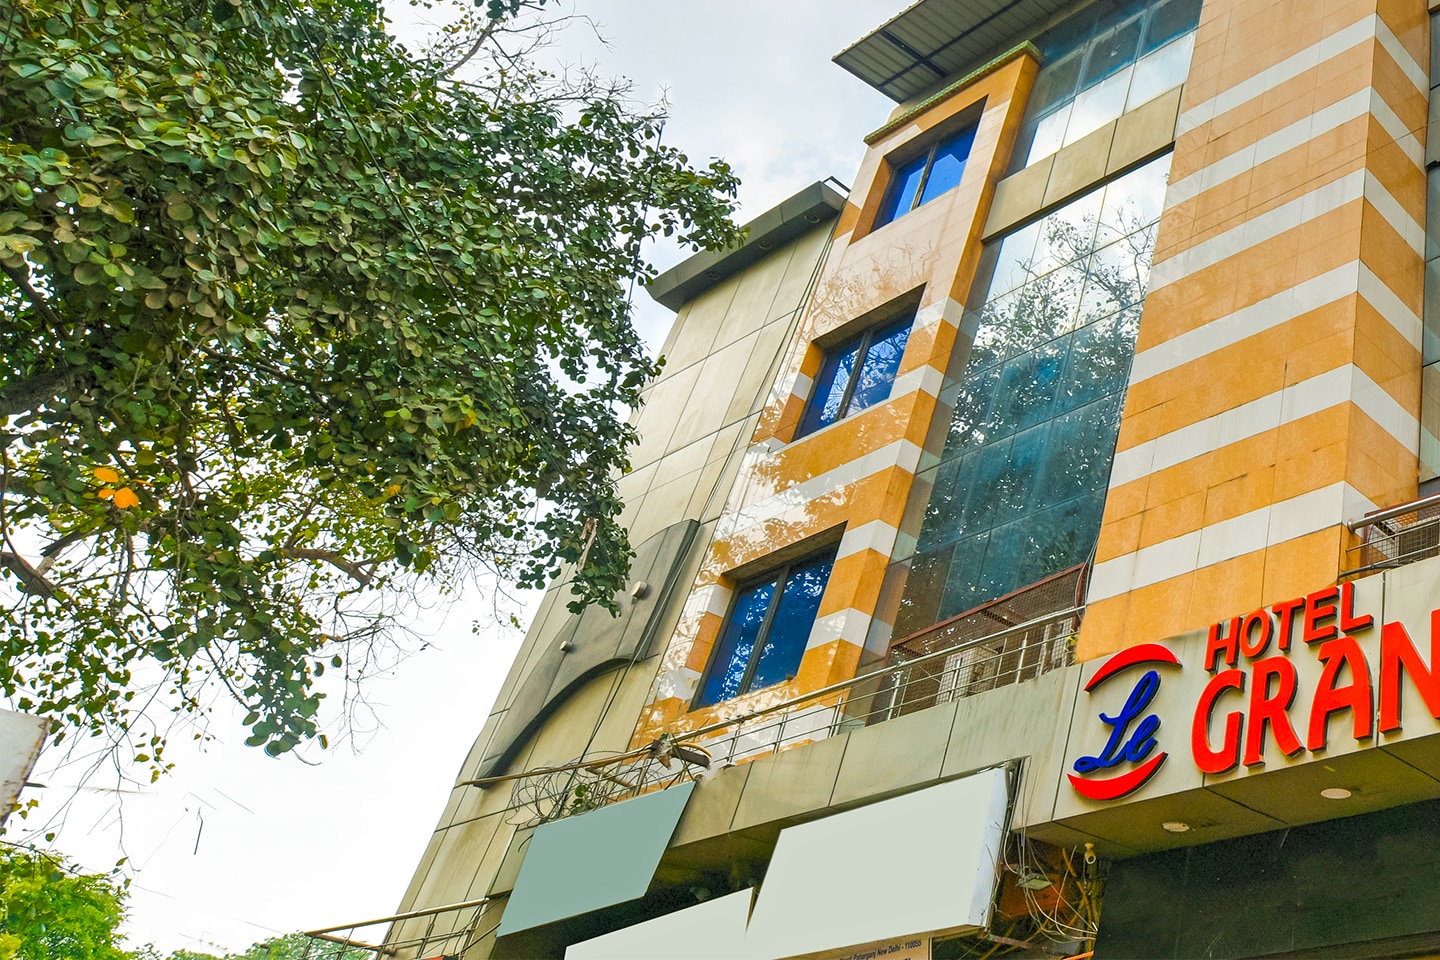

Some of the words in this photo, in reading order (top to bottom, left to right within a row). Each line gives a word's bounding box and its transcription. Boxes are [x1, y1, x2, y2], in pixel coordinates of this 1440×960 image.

[1204, 581, 1374, 673] HOTEL
[1073, 670, 1163, 774] Le
[877, 948, 889, 956] New
[888, 944, 901, 953] Delhi
